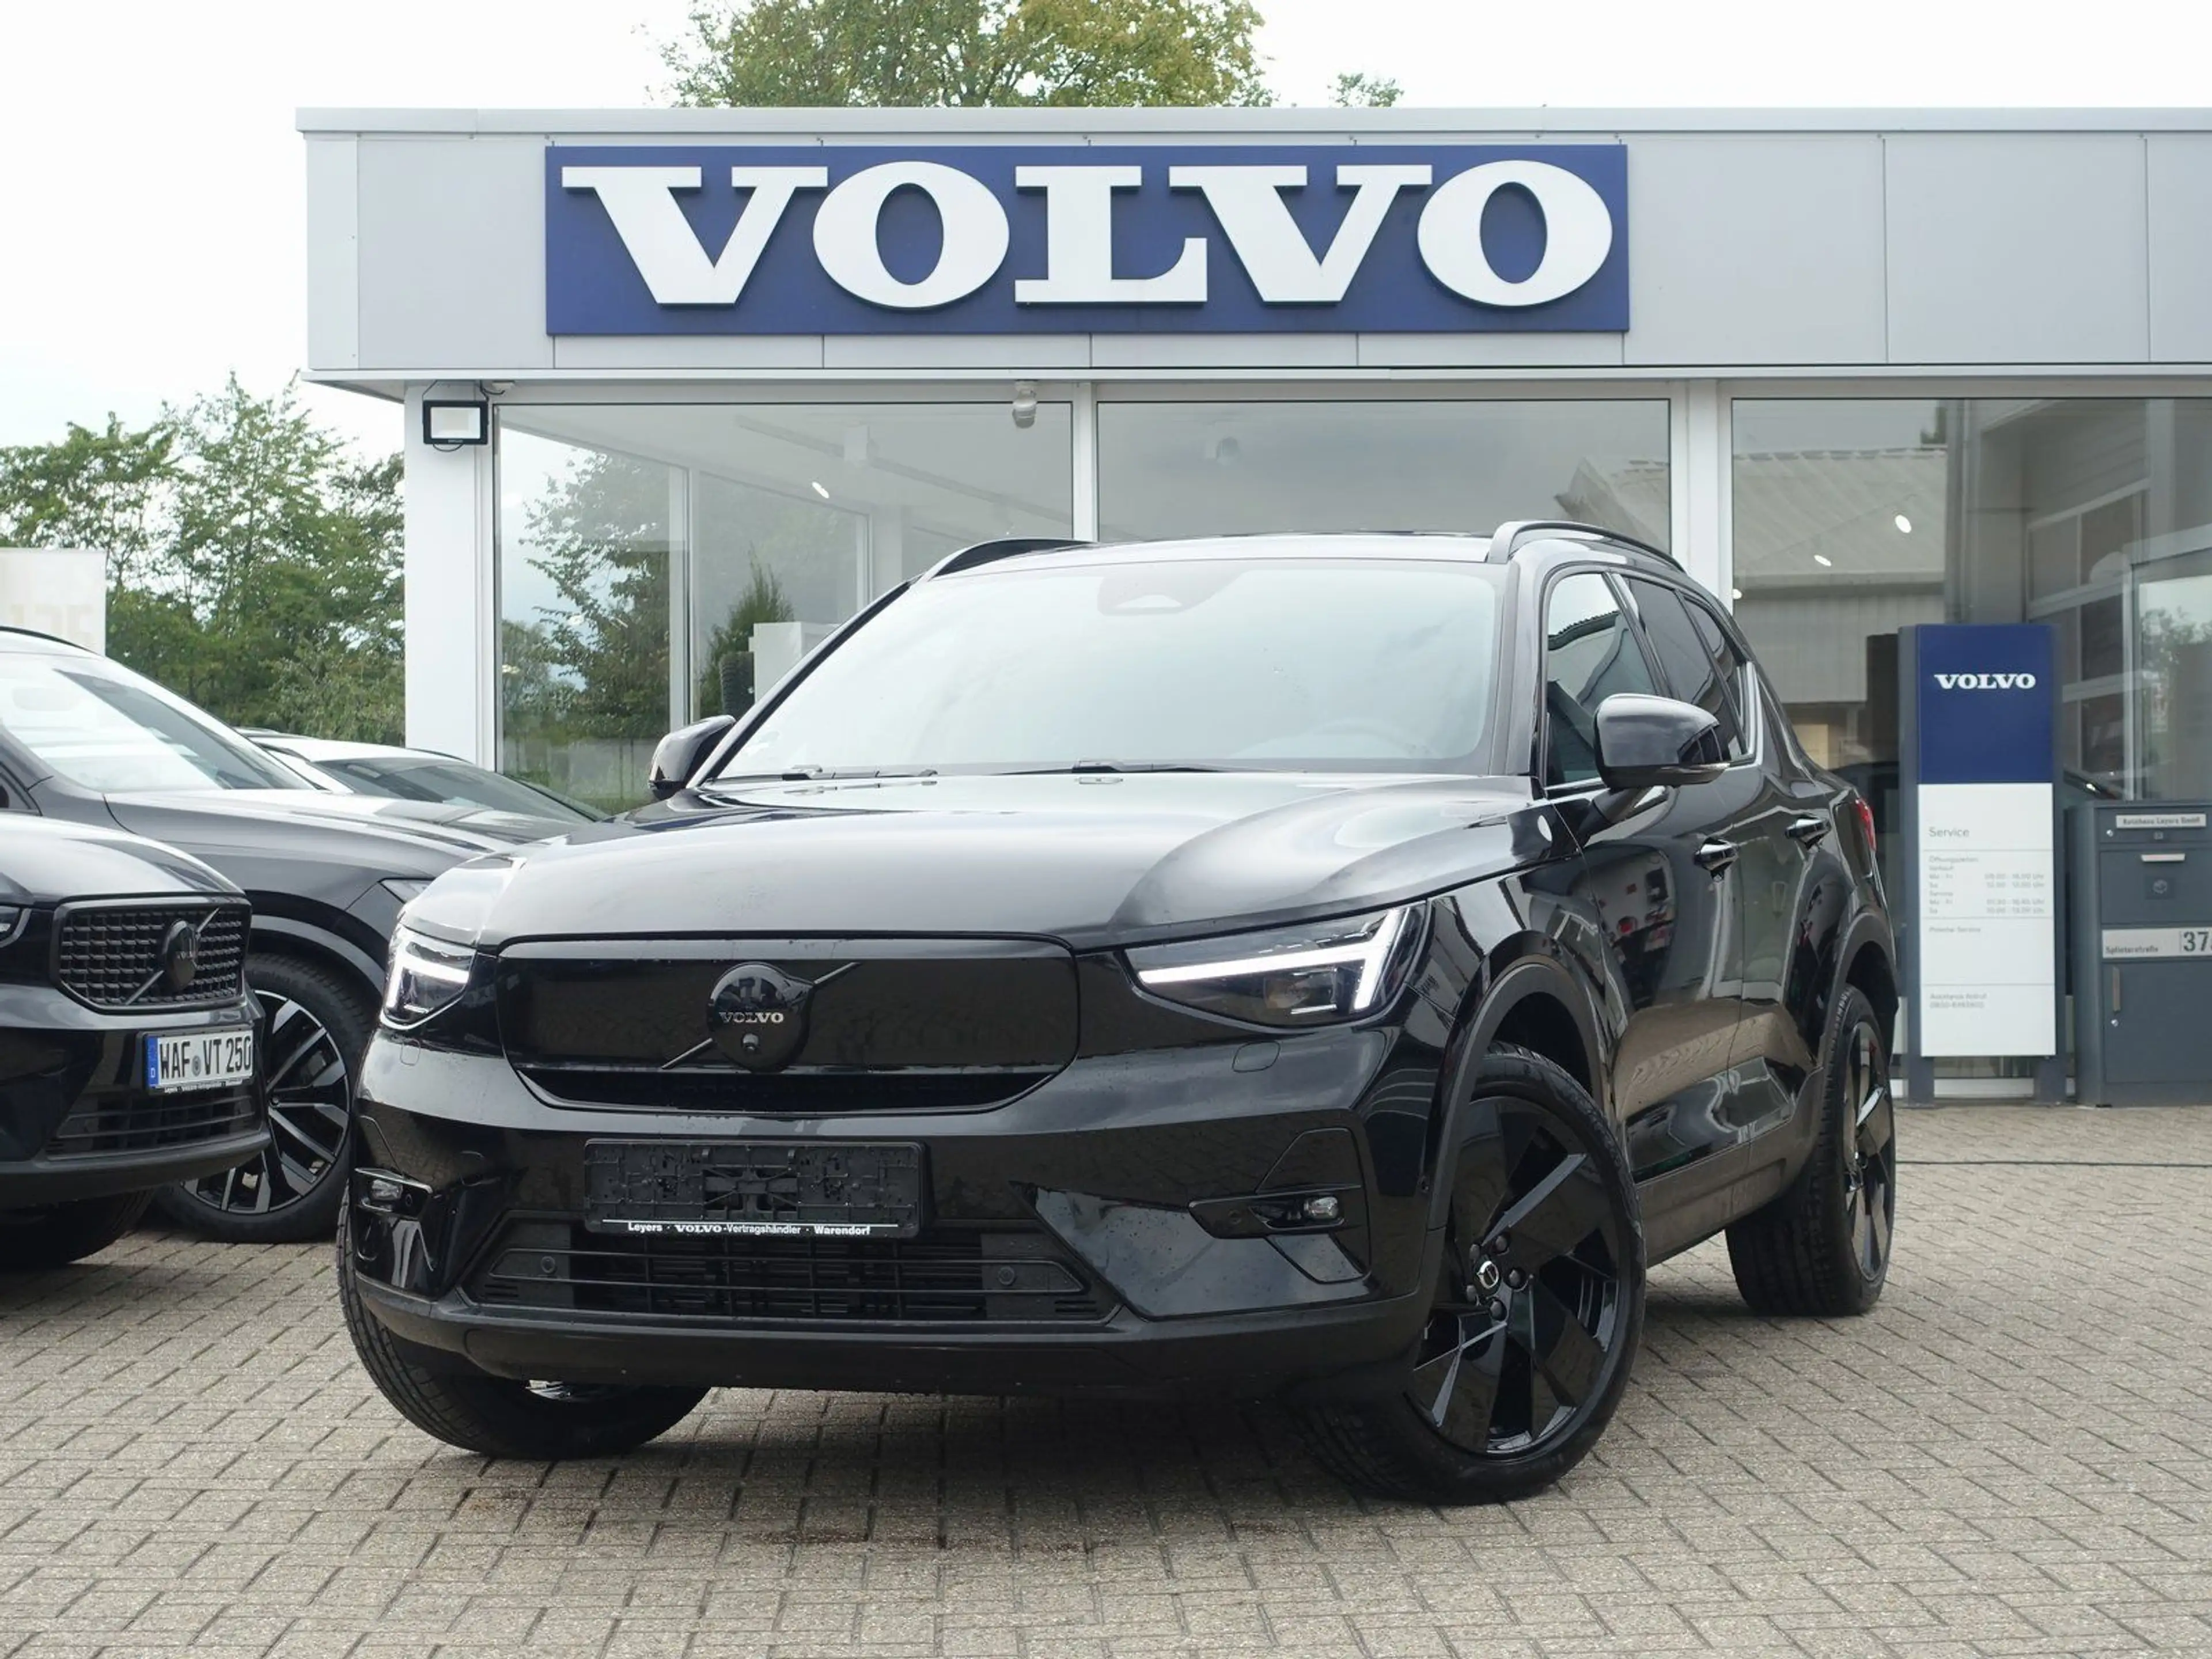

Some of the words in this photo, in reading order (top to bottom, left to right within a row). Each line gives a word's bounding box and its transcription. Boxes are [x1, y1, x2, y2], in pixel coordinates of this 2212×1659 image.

[562, 161, 1612, 308] VOLVO
[1934, 673, 2036, 690] VOLVO
[1929, 827, 1969, 837] Service
[719, 1012, 785, 1024] VOLVO
[160, 1041, 190, 1080] WAF
[203, 1039, 222, 1075] VT
[226, 1036, 251, 1073] 250
[628, 1221, 662, 1233] Leyers
[814, 1225, 870, 1236] Warendorf
